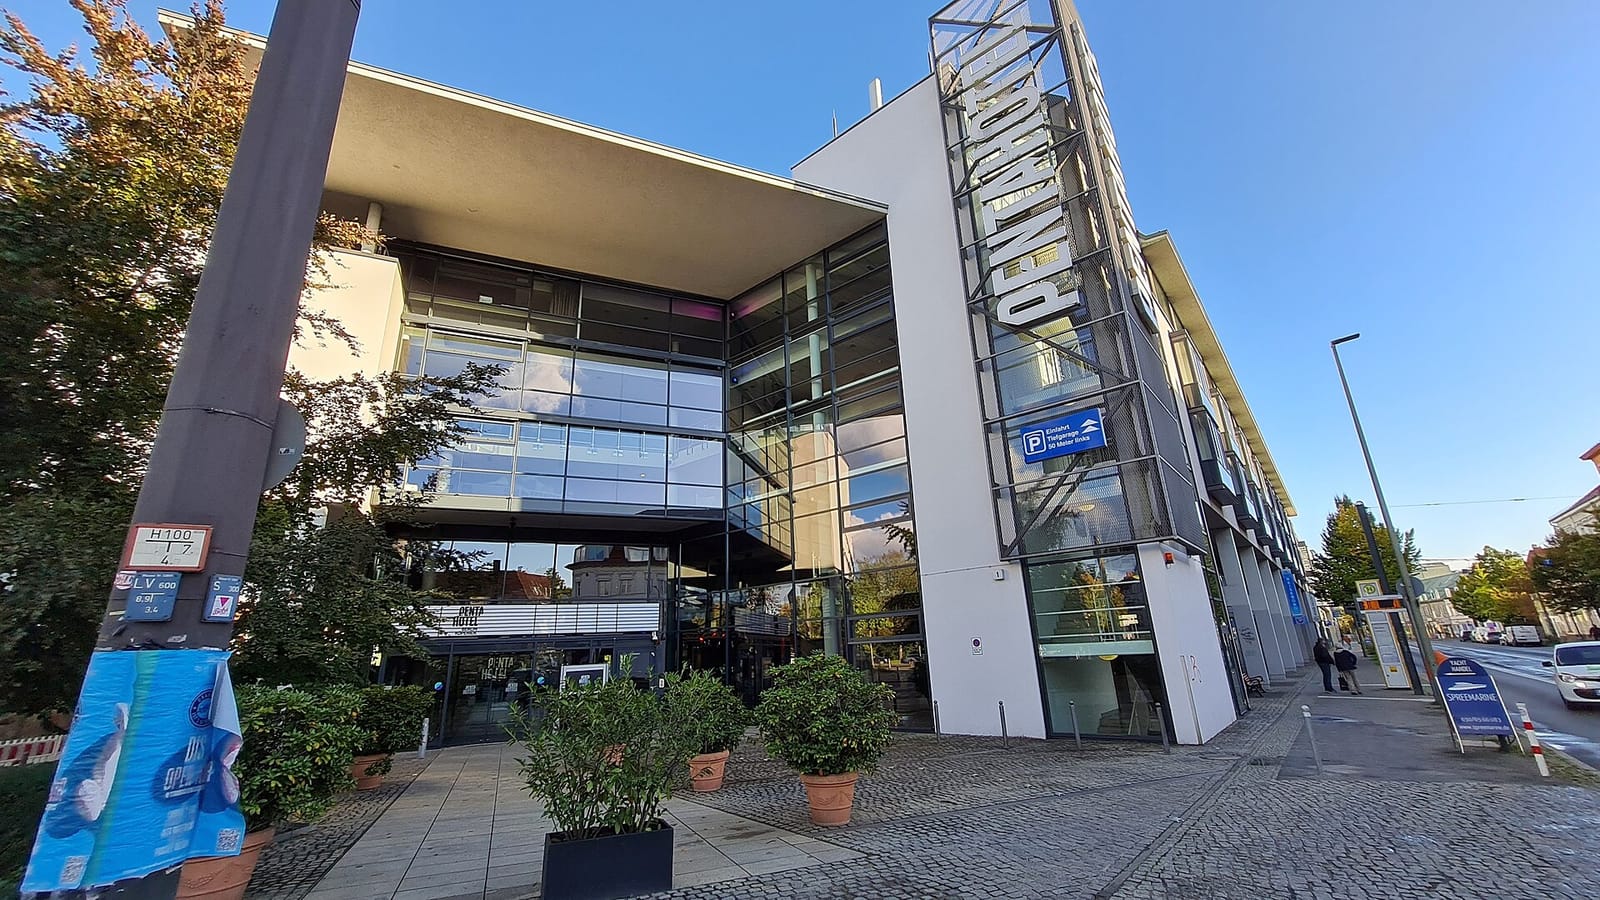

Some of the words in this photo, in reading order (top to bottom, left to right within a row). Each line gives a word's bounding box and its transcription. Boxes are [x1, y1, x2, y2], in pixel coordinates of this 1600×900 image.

[959, 3, 1081, 325] PENTAHOTEL
[1046, 424, 1070, 435] Einfahrt
[1047, 430, 1080, 442] Tiefgarage
[1056, 439, 1074, 448] Meter
[1074, 435, 1090, 443] links
[213, 581, 221, 591] S
[459, 606, 484, 617] PENTA
[452, 616, 478, 627] HOTEL
[487, 656, 515, 669] PENTA
[1446, 692, 1498, 702] SPREEMARINE
